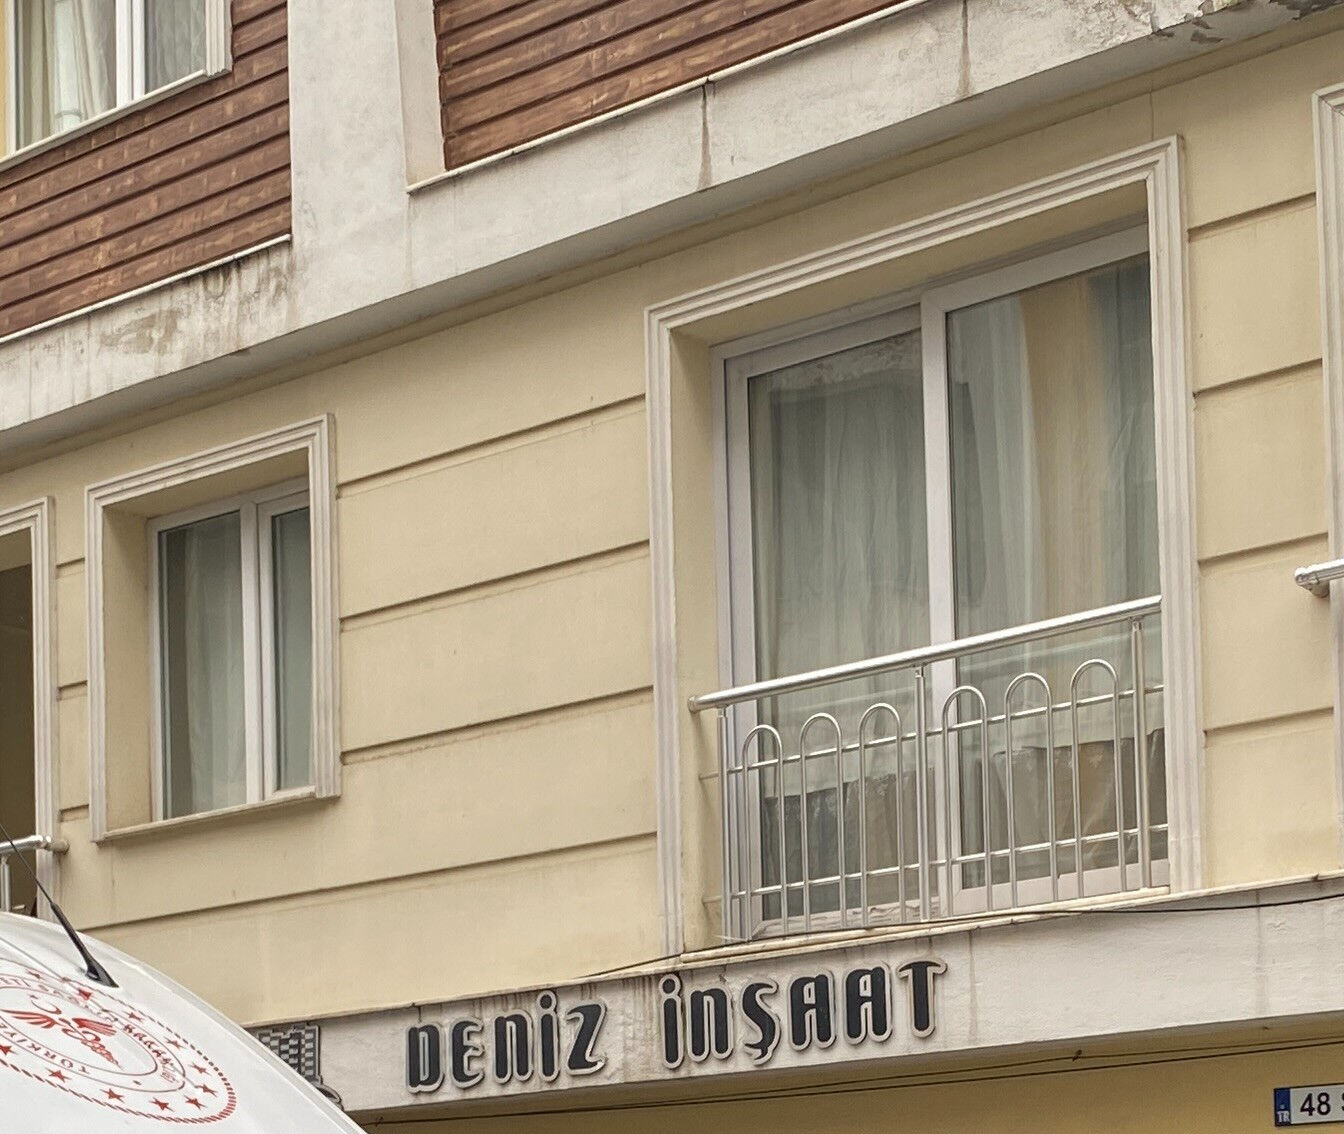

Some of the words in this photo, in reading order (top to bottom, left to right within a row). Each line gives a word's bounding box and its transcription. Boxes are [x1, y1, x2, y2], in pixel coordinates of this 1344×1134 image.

[405, 990, 608, 1094] DENİZ
[657, 957, 948, 1069] İNŞAAT
[1300, 1093, 1331, 1117] 48
